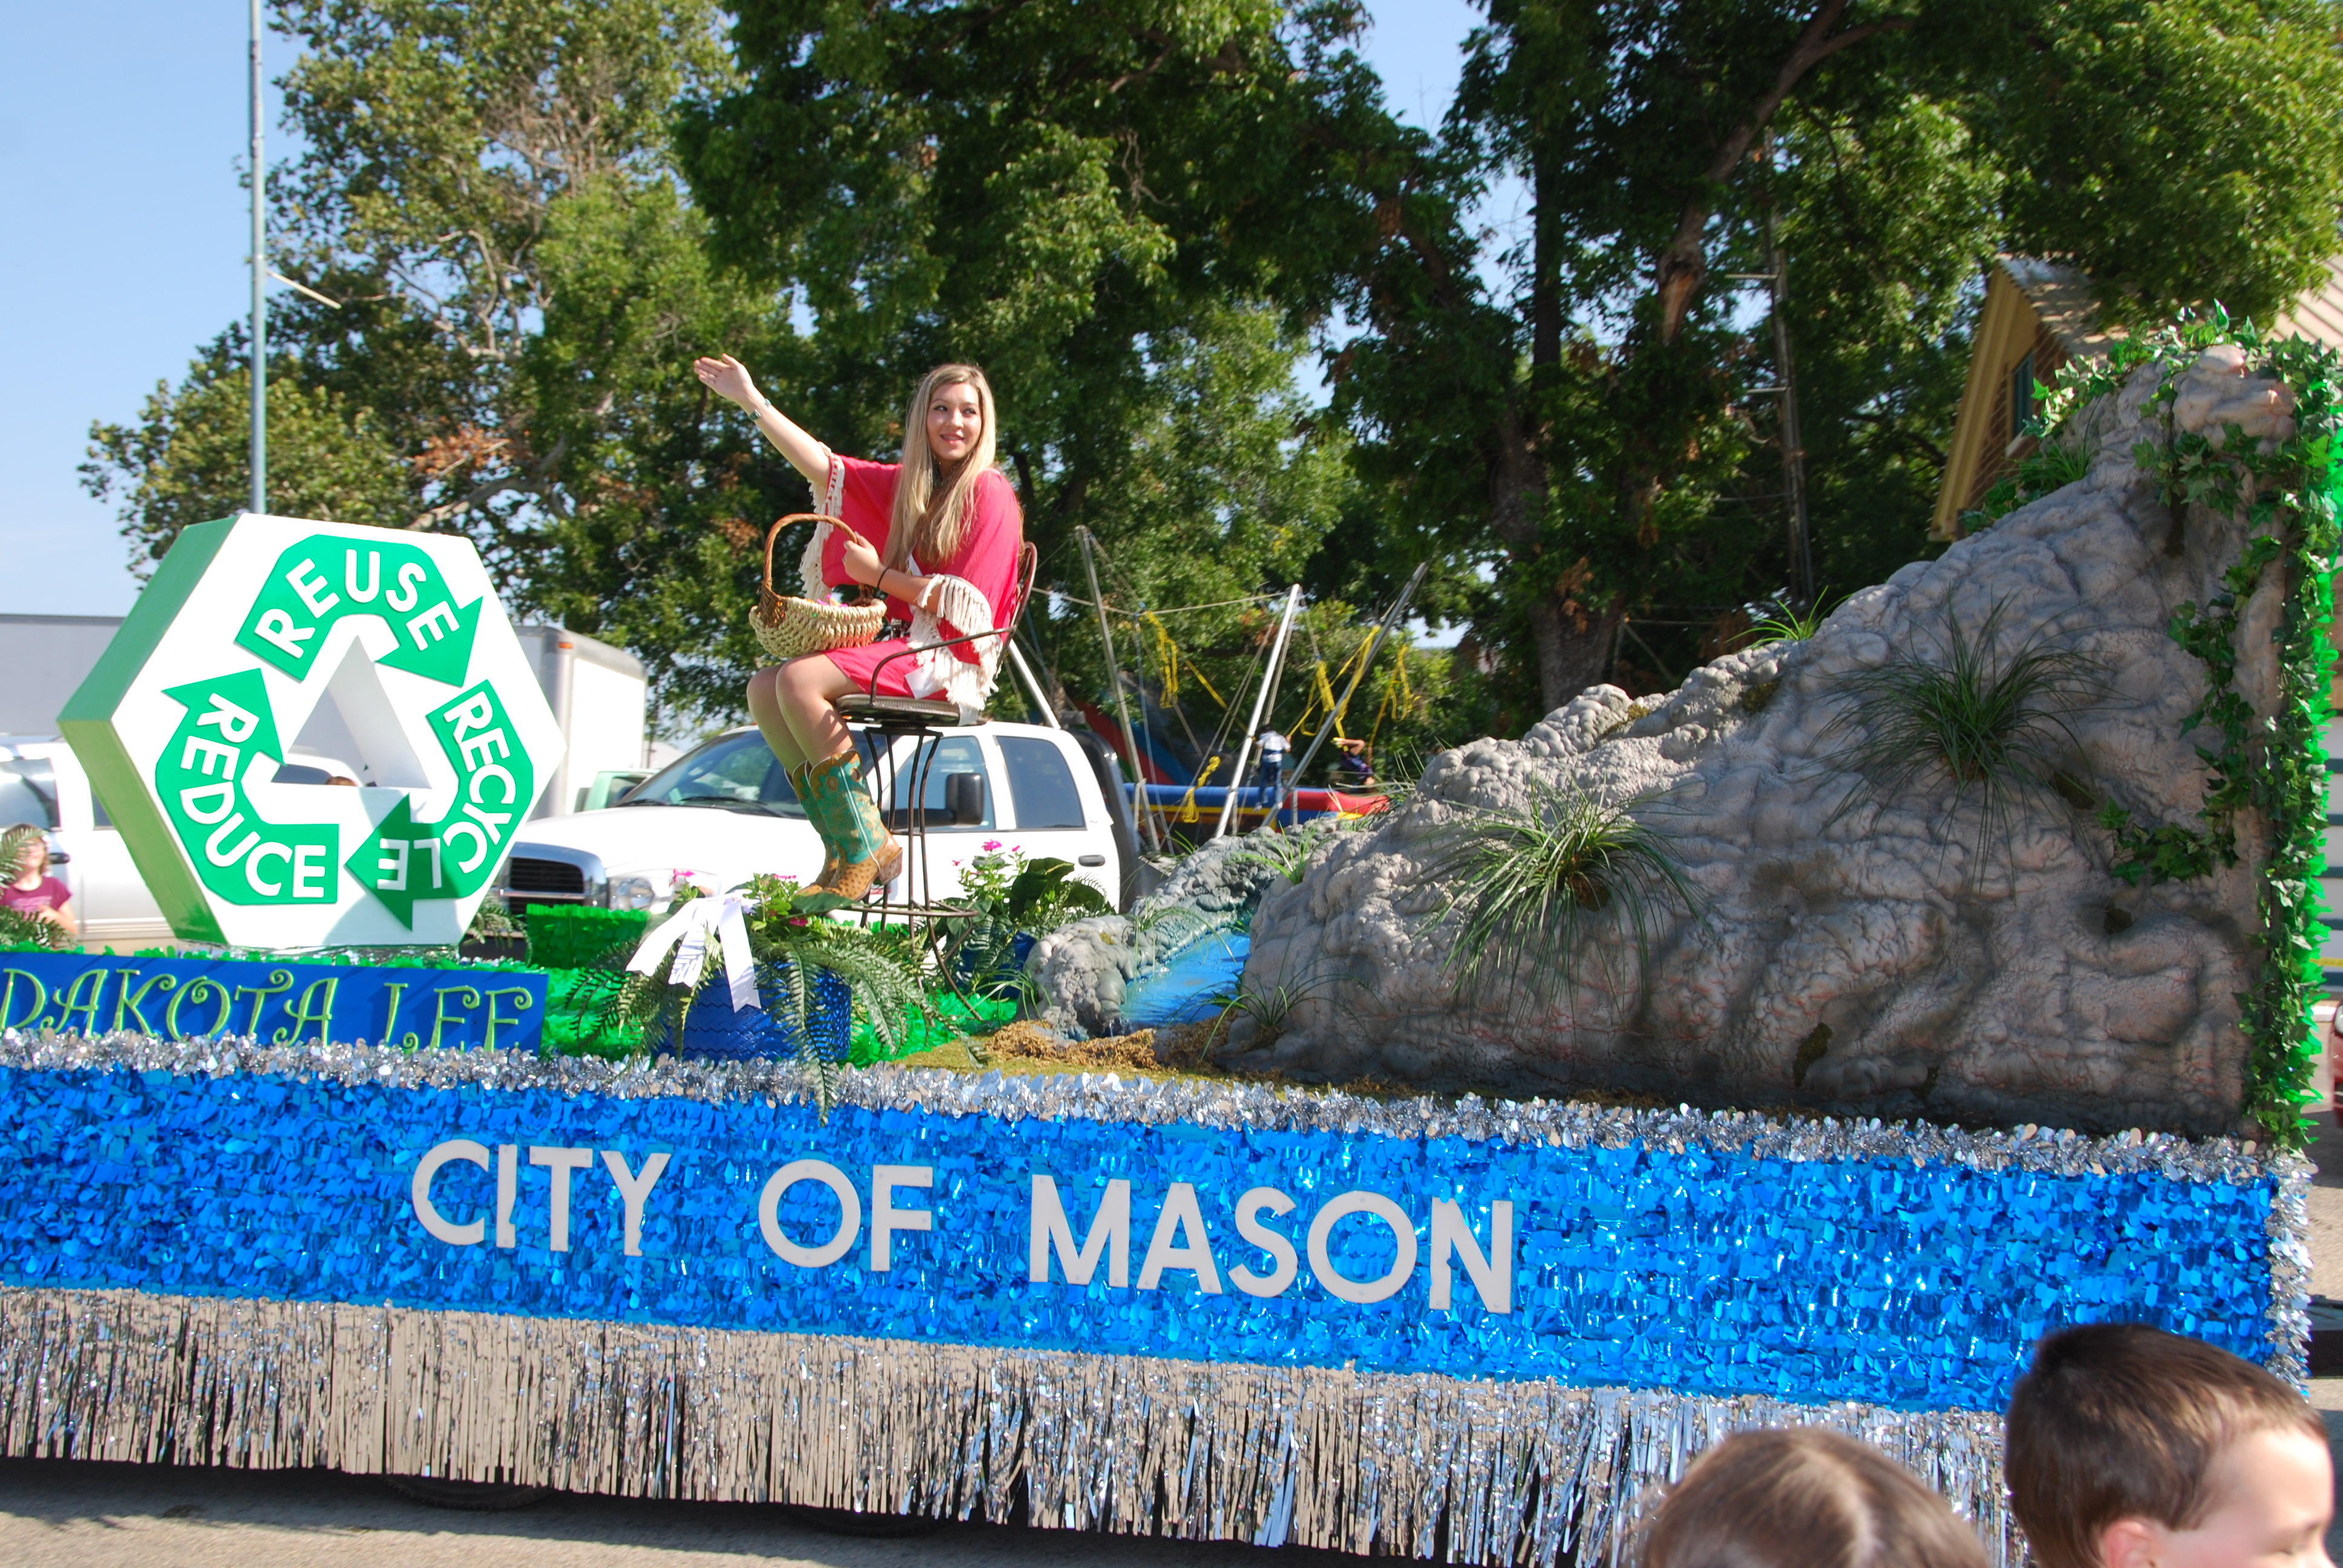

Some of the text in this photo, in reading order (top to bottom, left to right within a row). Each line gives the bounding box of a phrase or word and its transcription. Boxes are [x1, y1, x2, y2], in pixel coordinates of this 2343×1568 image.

[254, 549, 460, 658] REUSE
[180, 692, 327, 898] REDUCE
[376, 690, 516, 890] RECYCLE
[0, 969, 532, 1055] DAKOTA LEE
[412, 1140, 1515, 1315] CITY OF MASON
